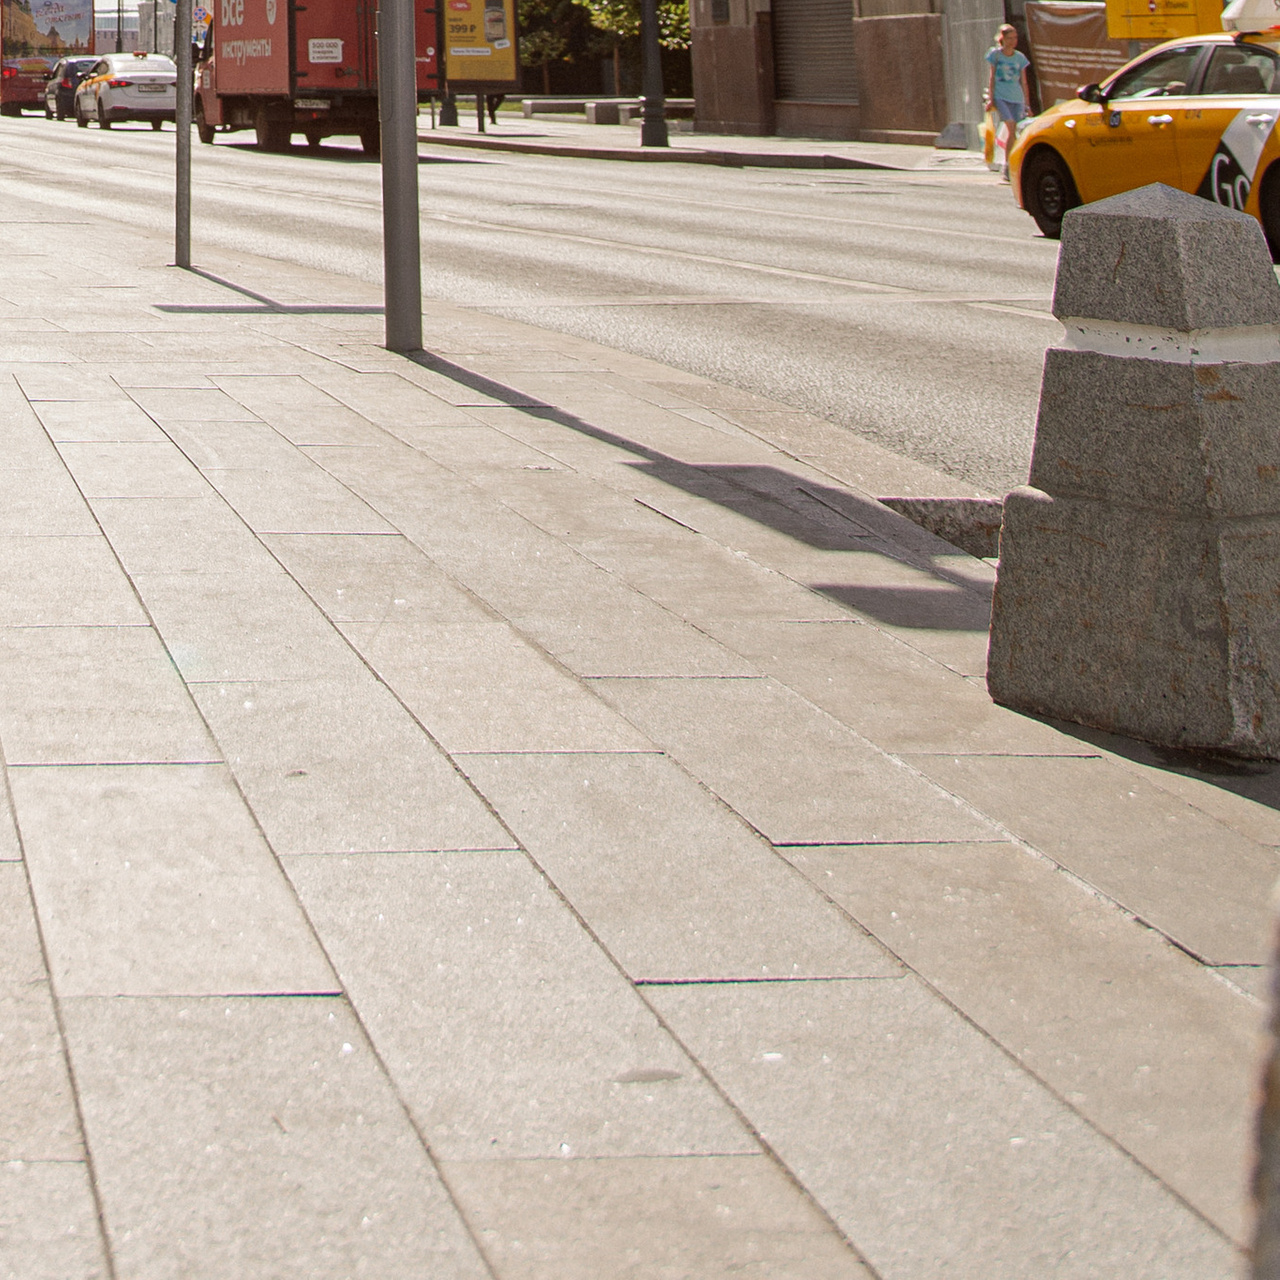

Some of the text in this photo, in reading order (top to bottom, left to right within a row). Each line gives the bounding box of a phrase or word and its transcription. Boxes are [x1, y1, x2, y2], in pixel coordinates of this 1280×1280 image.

[449, 24, 468, 33] 399
[221, 38, 272, 66] инструменты
[312, 41, 338, 49] 500 000
[1211, 152, 1252, 210] Go
